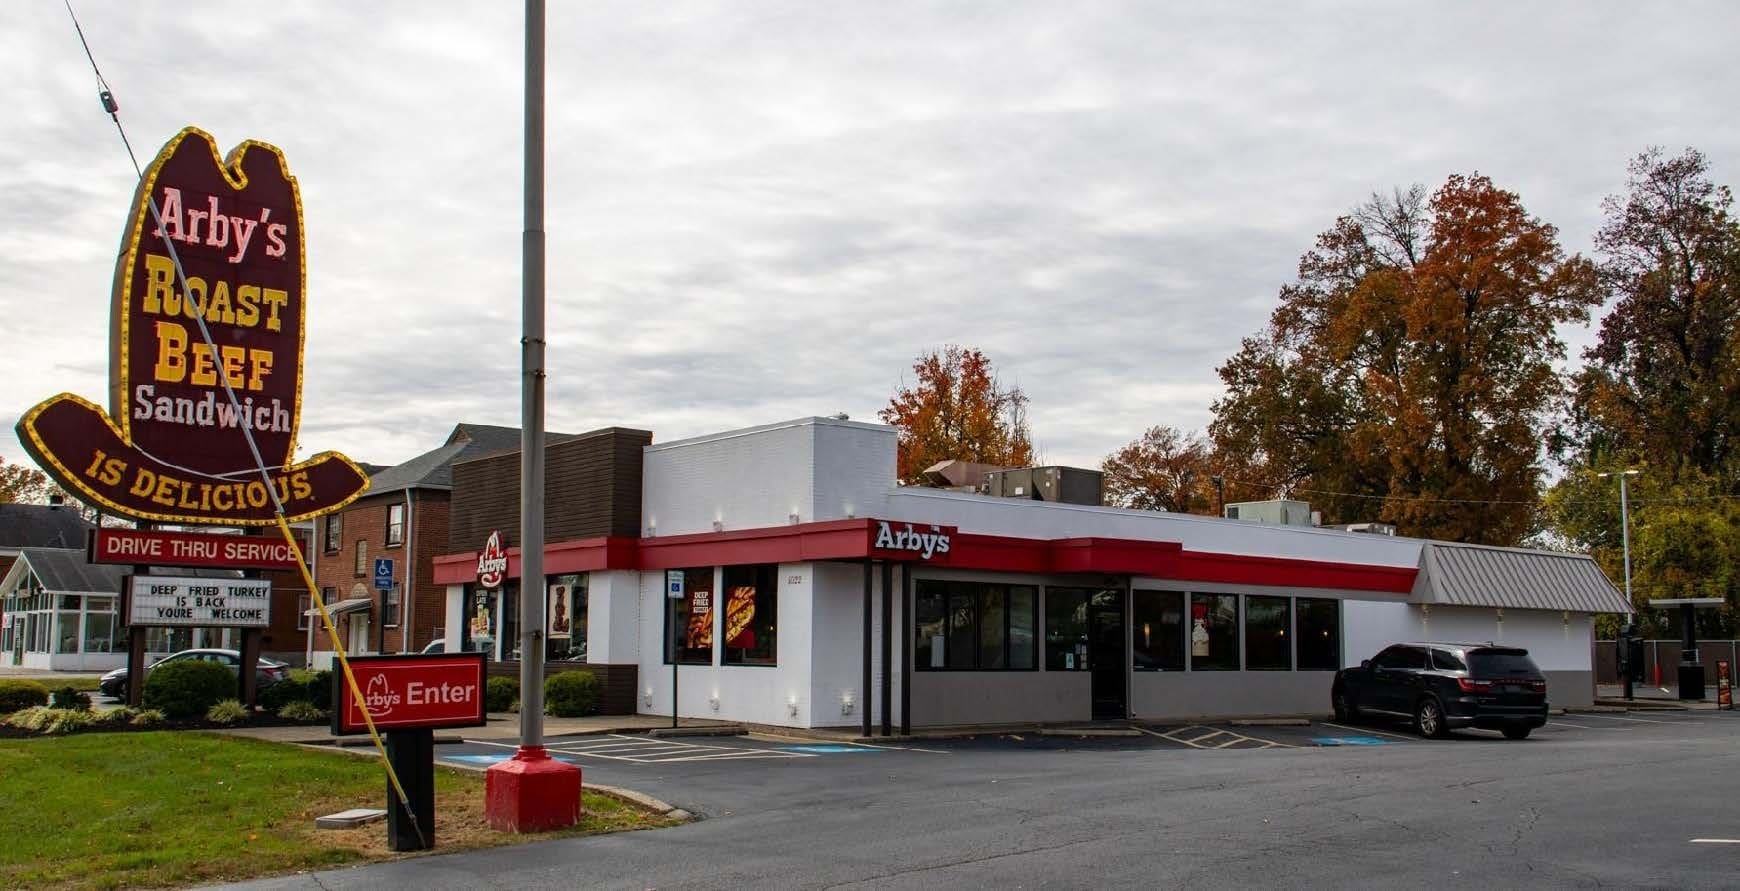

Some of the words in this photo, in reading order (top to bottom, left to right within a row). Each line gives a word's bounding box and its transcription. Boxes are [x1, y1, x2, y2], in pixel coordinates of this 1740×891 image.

[152, 187, 287, 263] Arby's
[142, 254, 288, 332] ROAST
[154, 321, 273, 391] BEEF
[134, 384, 291, 432] Sandwich
[85, 449, 128, 487] IS
[129, 471, 313, 512] DELICIOUS
[107, 536, 163, 556] DRIVE
[170, 540, 217, 559] THRU
[224, 542, 298, 561] SERVICE
[876, 521, 950, 560] Arby's
[477, 553, 507, 576] Arby's
[151, 585, 178, 595] DEEP
[189, 586, 220, 596] FRIED
[228, 586, 268, 598] TURKEY
[176, 596, 187, 607] IS
[196, 597, 226, 607] BACK
[157, 607, 193, 618] YOURE
[211, 609, 262, 619] WELCOME
[354, 690, 401, 709] rby's
[407, 681, 475, 705] Enter
